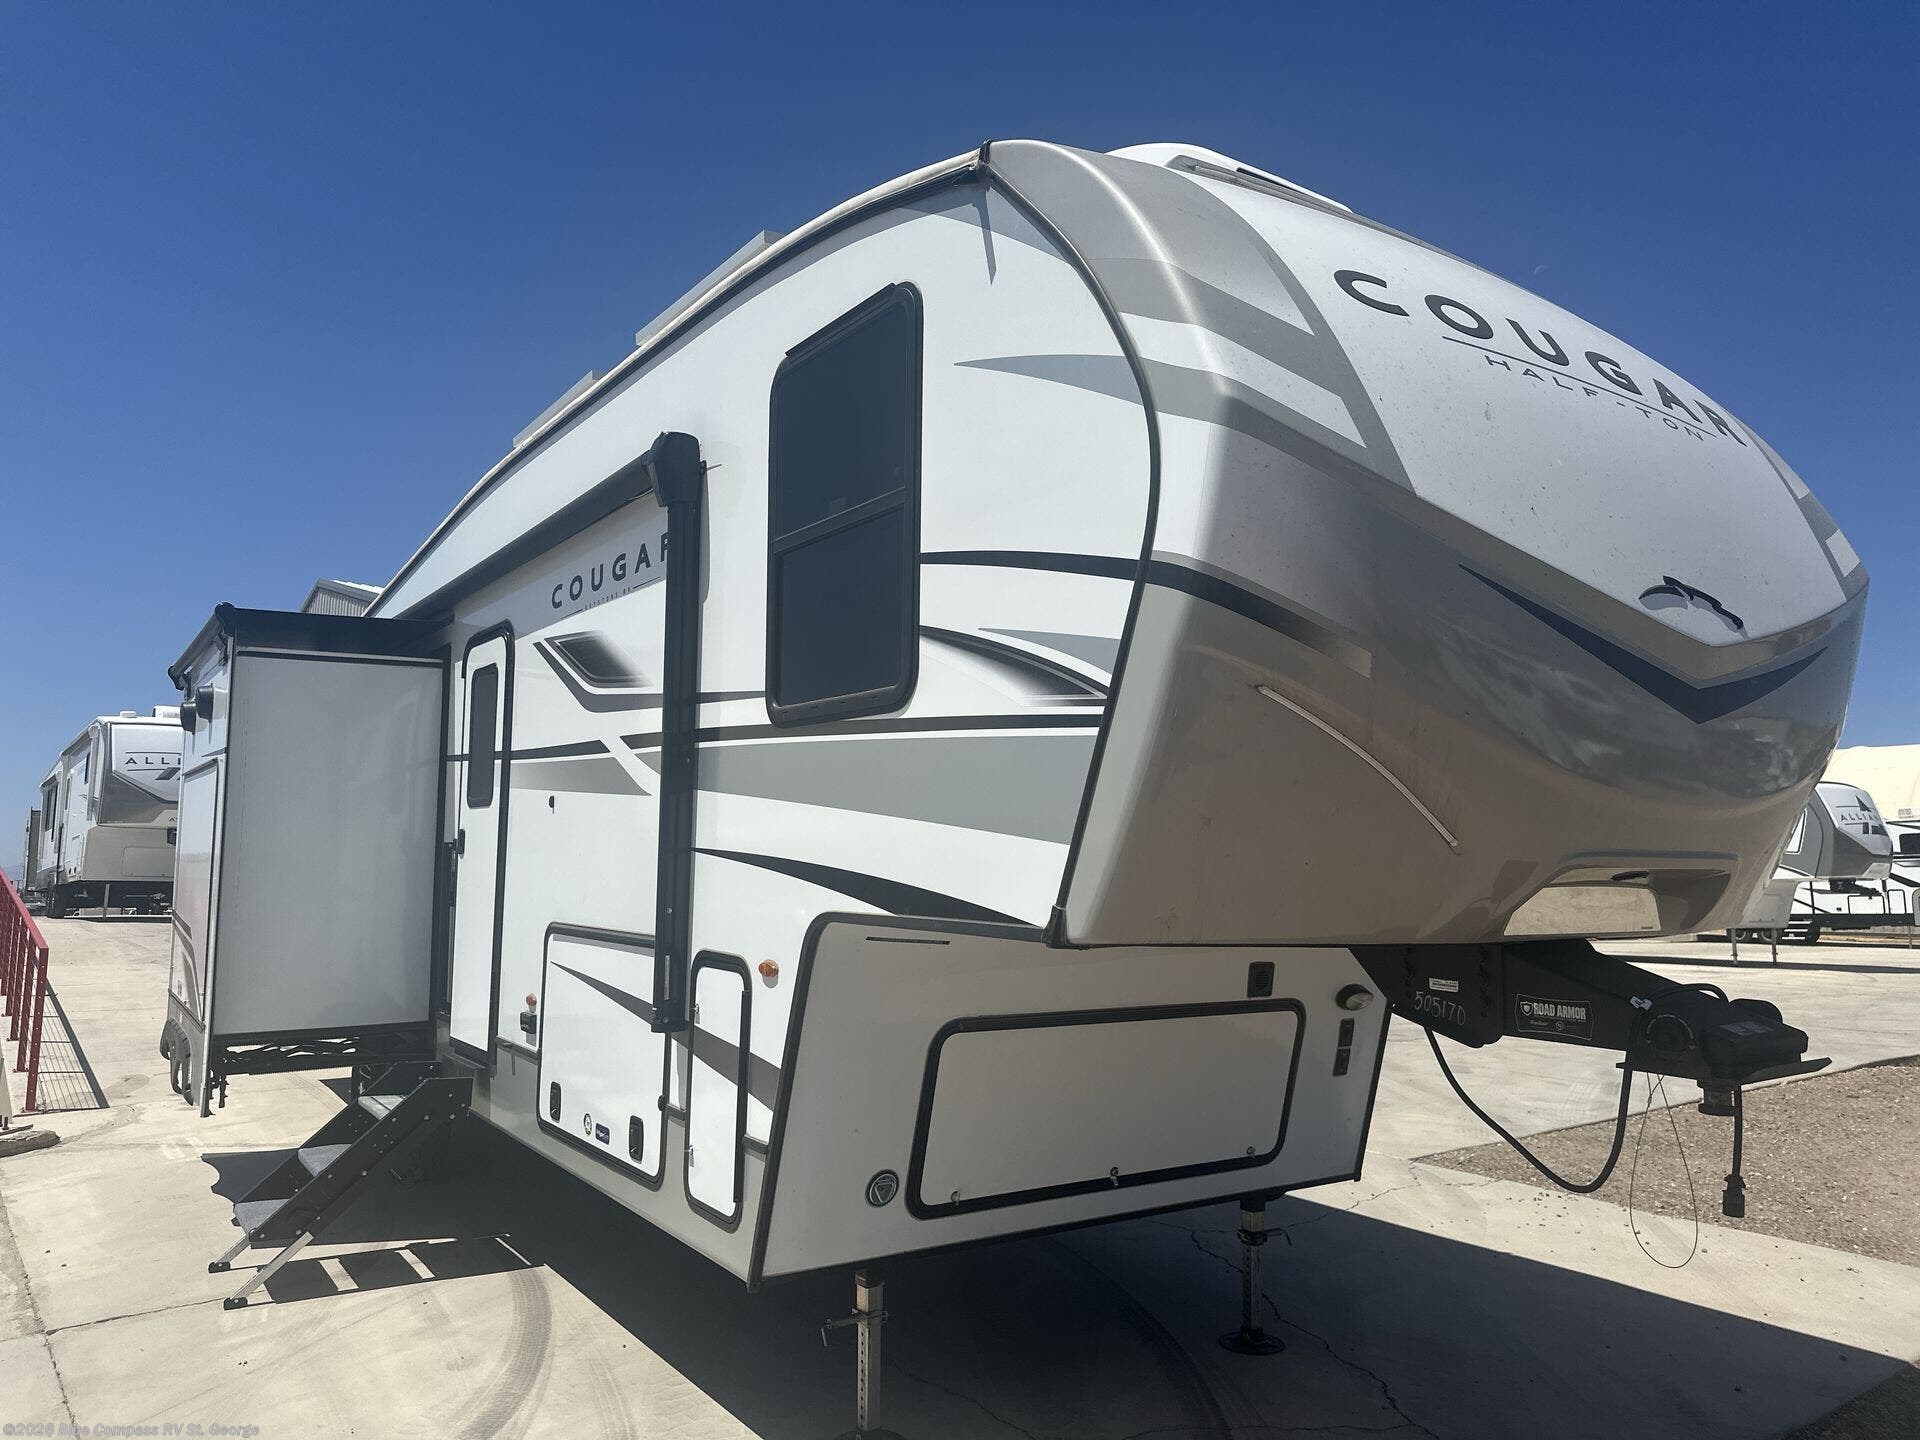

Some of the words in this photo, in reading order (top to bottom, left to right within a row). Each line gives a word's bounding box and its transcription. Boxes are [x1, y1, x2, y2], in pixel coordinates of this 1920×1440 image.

[1334, 269, 1747, 447] COUGAR
[1485, 354, 1704, 442] HALF-TON
[125, 756, 182, 765] ALLI
[1414, 990, 1467, 1026] 505170
[1533, 1002, 1556, 1017] ROAD
[1556, 1005, 1587, 1020] ARMOR
